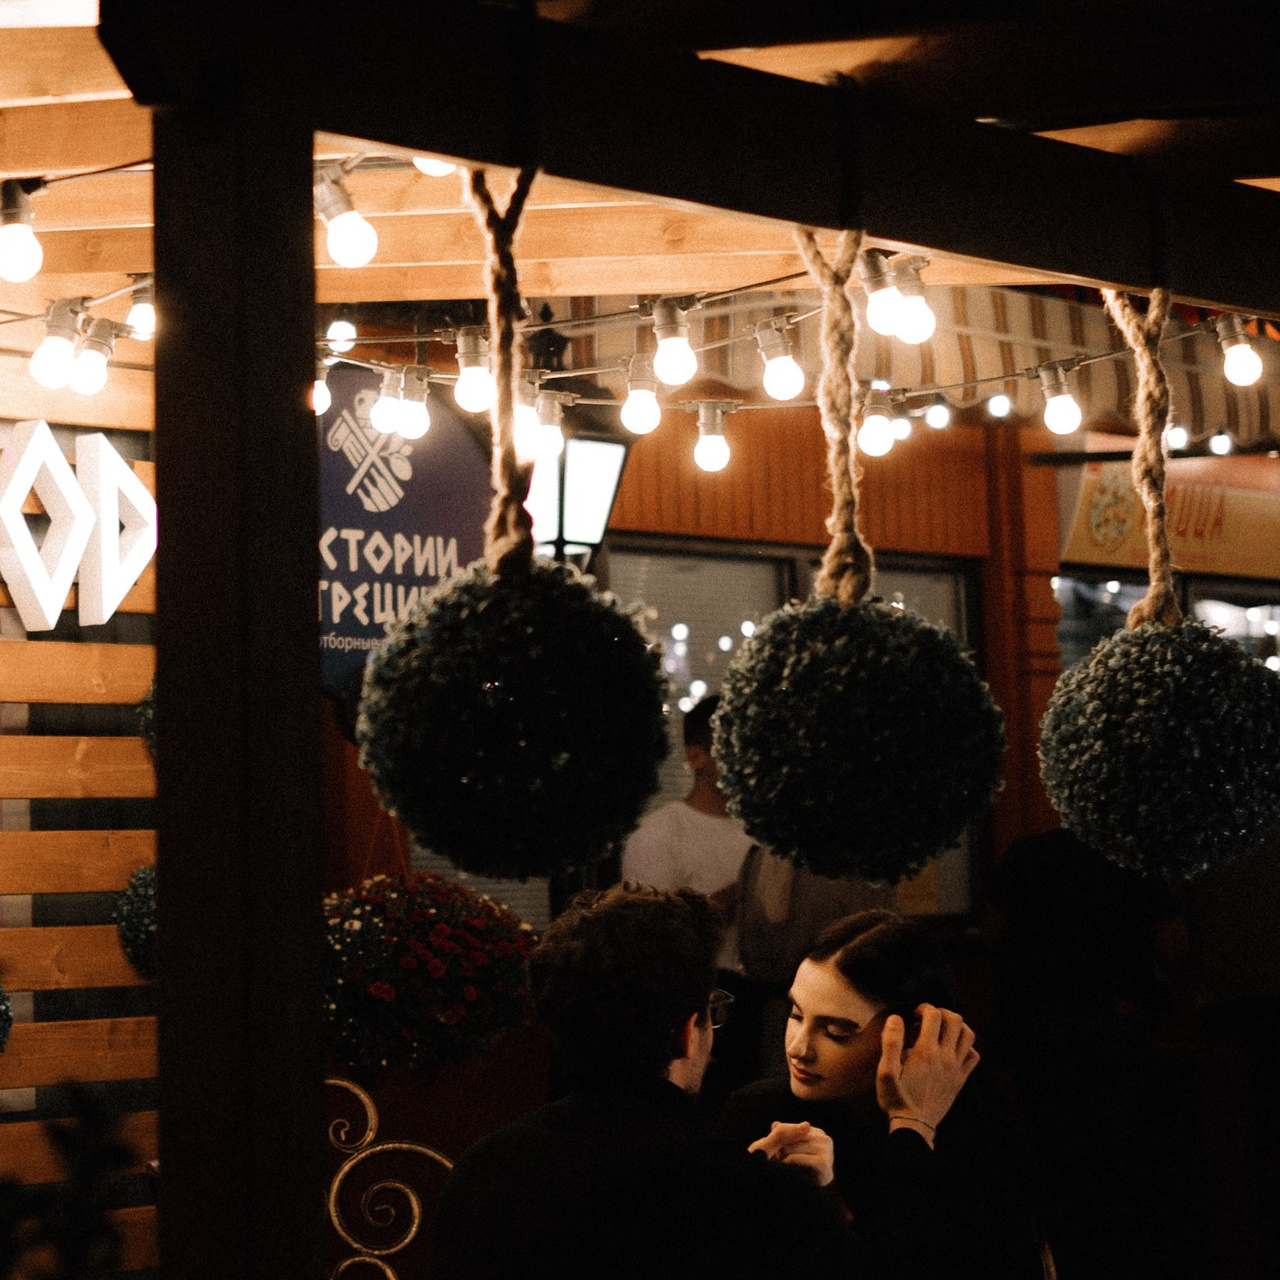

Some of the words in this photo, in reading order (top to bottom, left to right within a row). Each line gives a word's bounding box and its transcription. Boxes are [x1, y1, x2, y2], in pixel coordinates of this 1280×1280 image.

[318, 526, 458, 577] СТОРИИ
[318, 579, 429, 626] ГРЕЦИ
[320, 632, 379, 653] тборные
